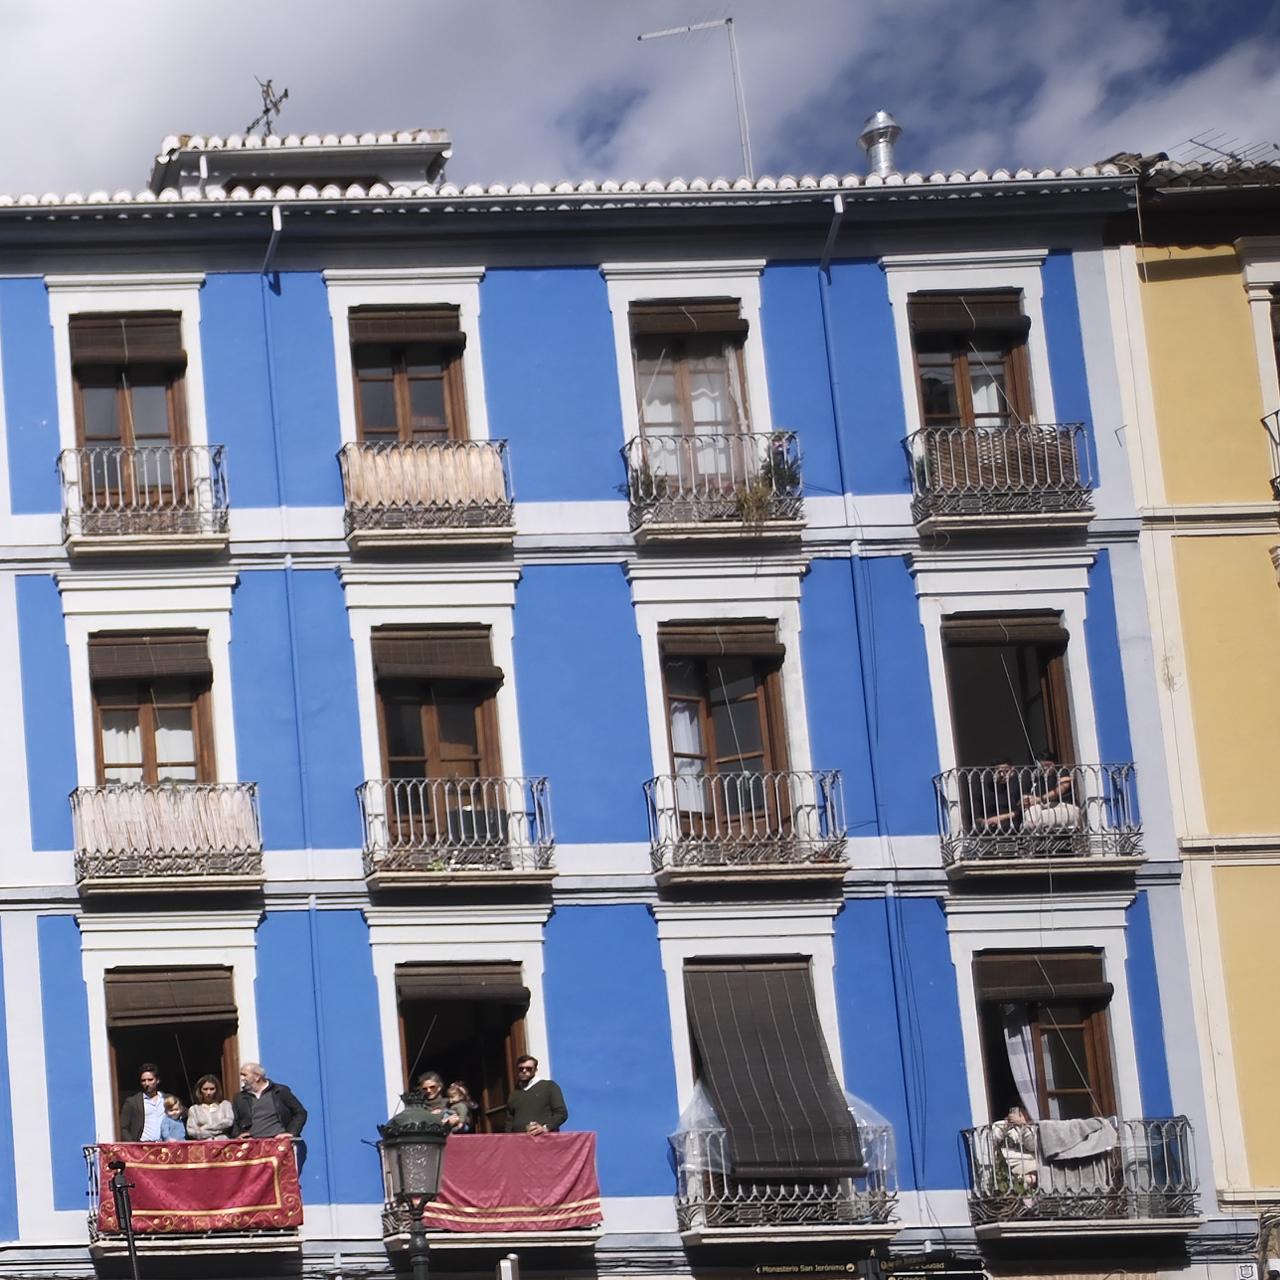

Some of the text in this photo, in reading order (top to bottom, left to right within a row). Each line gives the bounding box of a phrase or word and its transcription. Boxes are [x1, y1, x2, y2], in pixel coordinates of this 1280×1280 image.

[762, 1263, 845, 1273] Monasterio San Jerónimo
